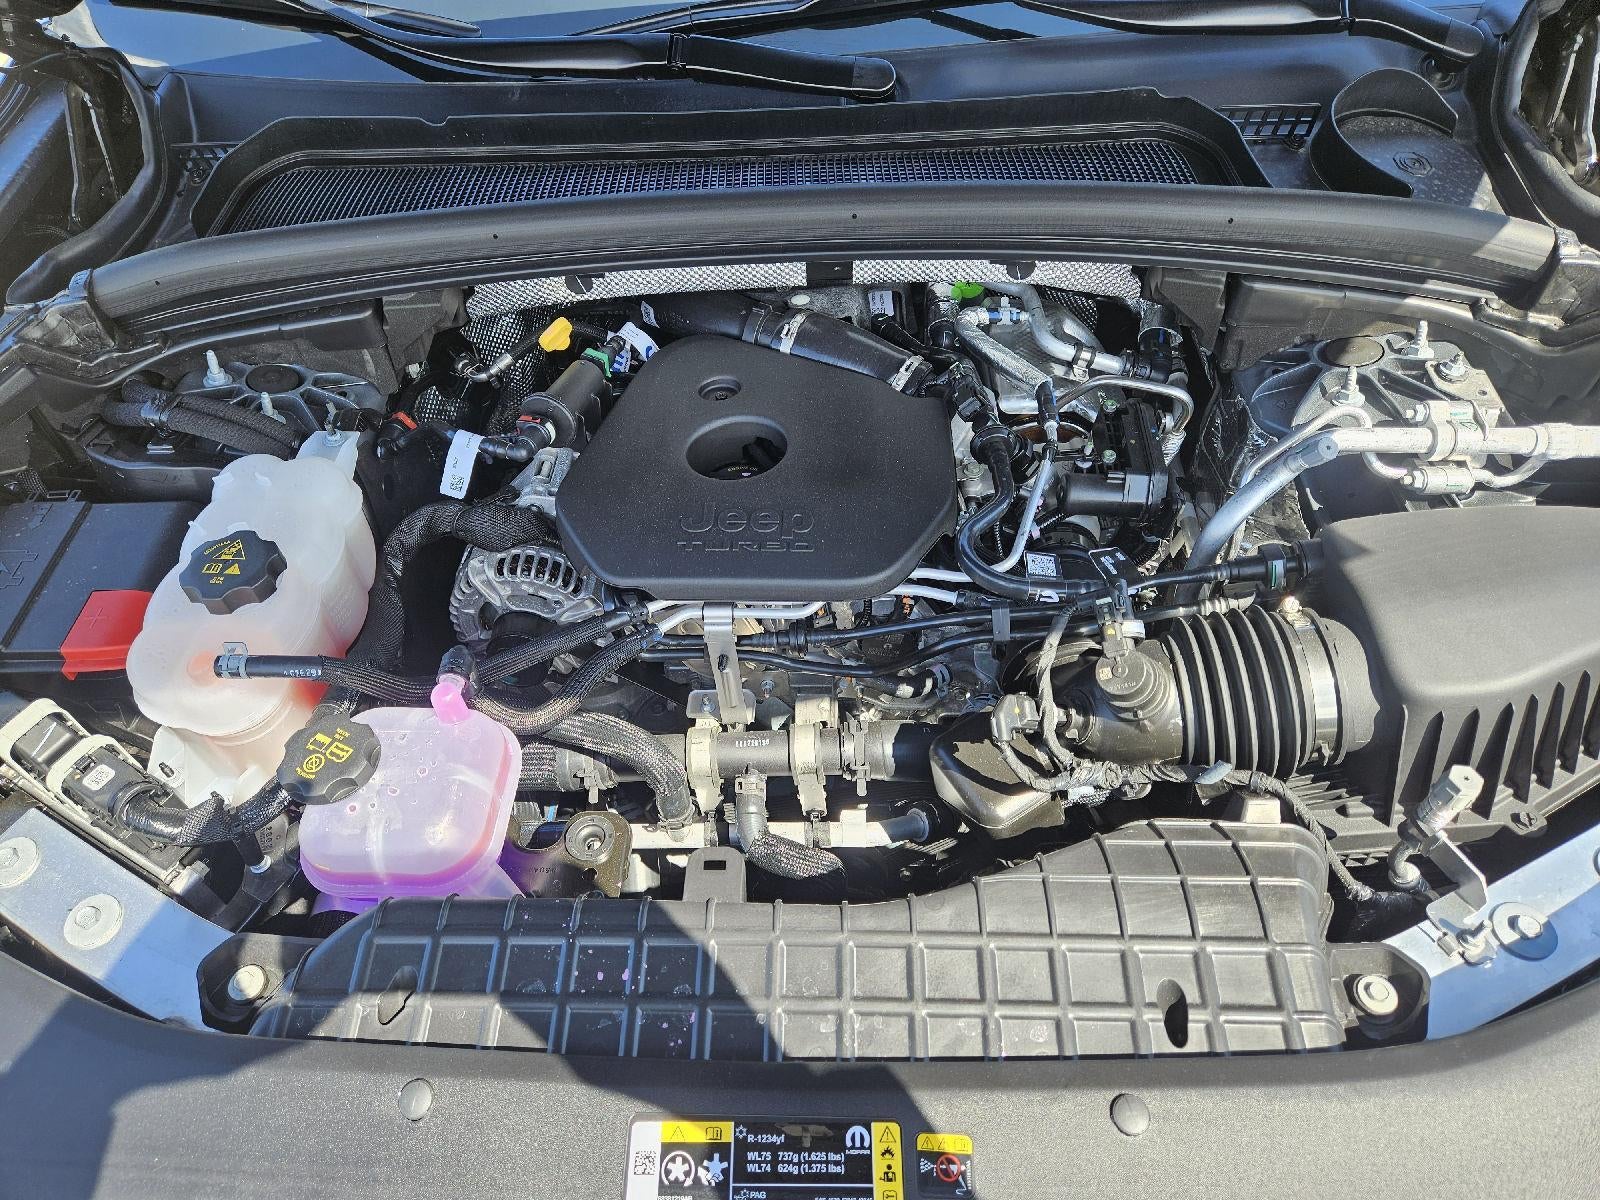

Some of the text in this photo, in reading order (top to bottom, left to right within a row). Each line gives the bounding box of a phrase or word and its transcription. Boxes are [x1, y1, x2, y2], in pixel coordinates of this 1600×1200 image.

[679, 500, 815, 539] Jeep
[677, 541, 815, 552] TURBO
[747, 1134, 785, 1145] R-1234yf
[747, 1152, 845, 1162] WL75 737g (1.625 lbs)
[747, 1164, 845, 1174] WL74 624g (1.375 lbs)
[750, 1191, 767, 1199] PAG
